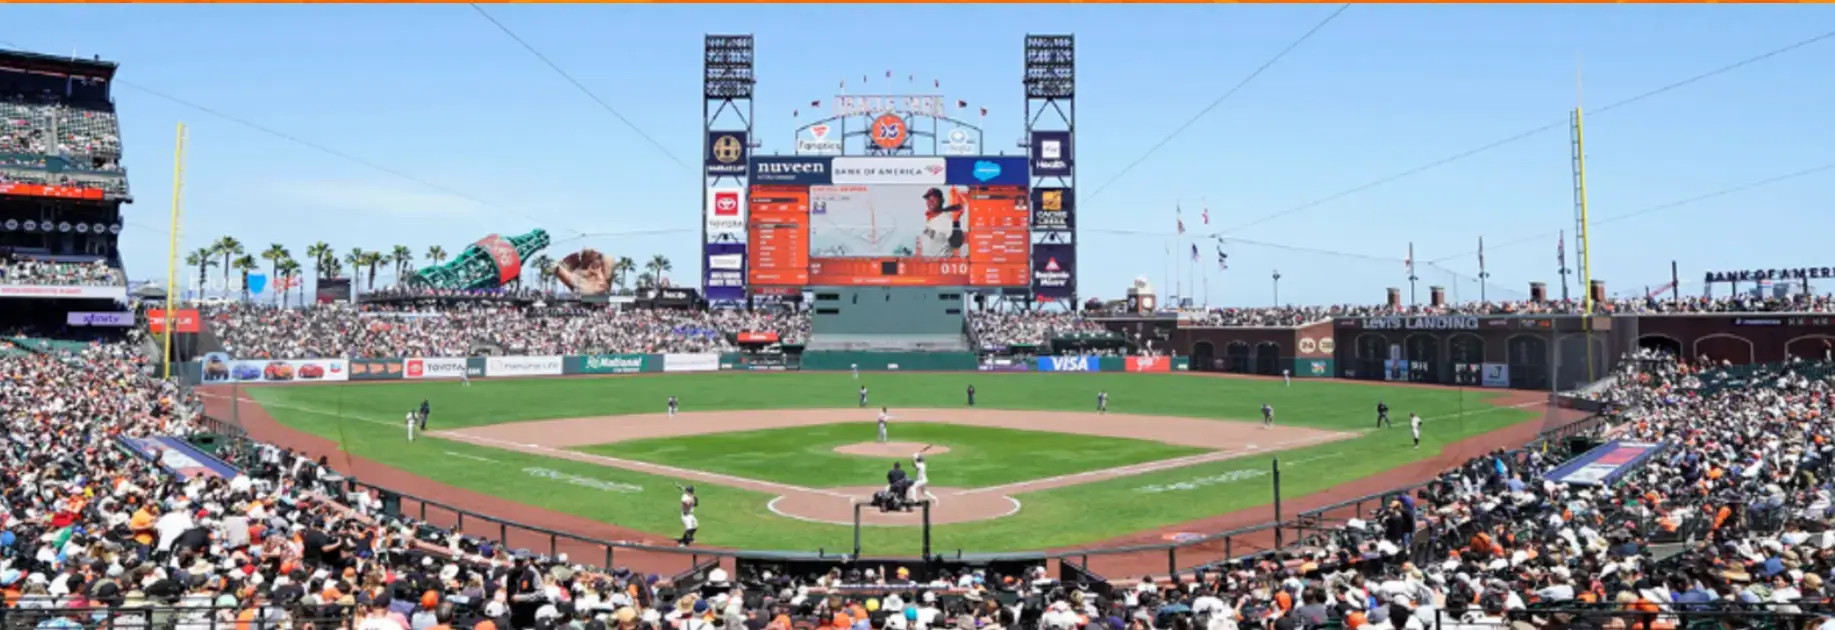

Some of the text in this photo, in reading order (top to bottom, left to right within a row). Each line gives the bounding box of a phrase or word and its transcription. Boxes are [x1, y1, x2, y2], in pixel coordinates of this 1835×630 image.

[757, 162, 825, 174] nuveen
[1036, 160, 1067, 169] Health
[834, 167, 923, 177] BANK OF AMERICA
[1705, 269, 1750, 283] BANK
[1754, 268, 1777, 281] OF
[1405, 316, 1479, 330] LANDING
[601, 355, 642, 367] National
[1051, 355, 1090, 371] VISA
[427, 362, 466, 373] TOYOTA
